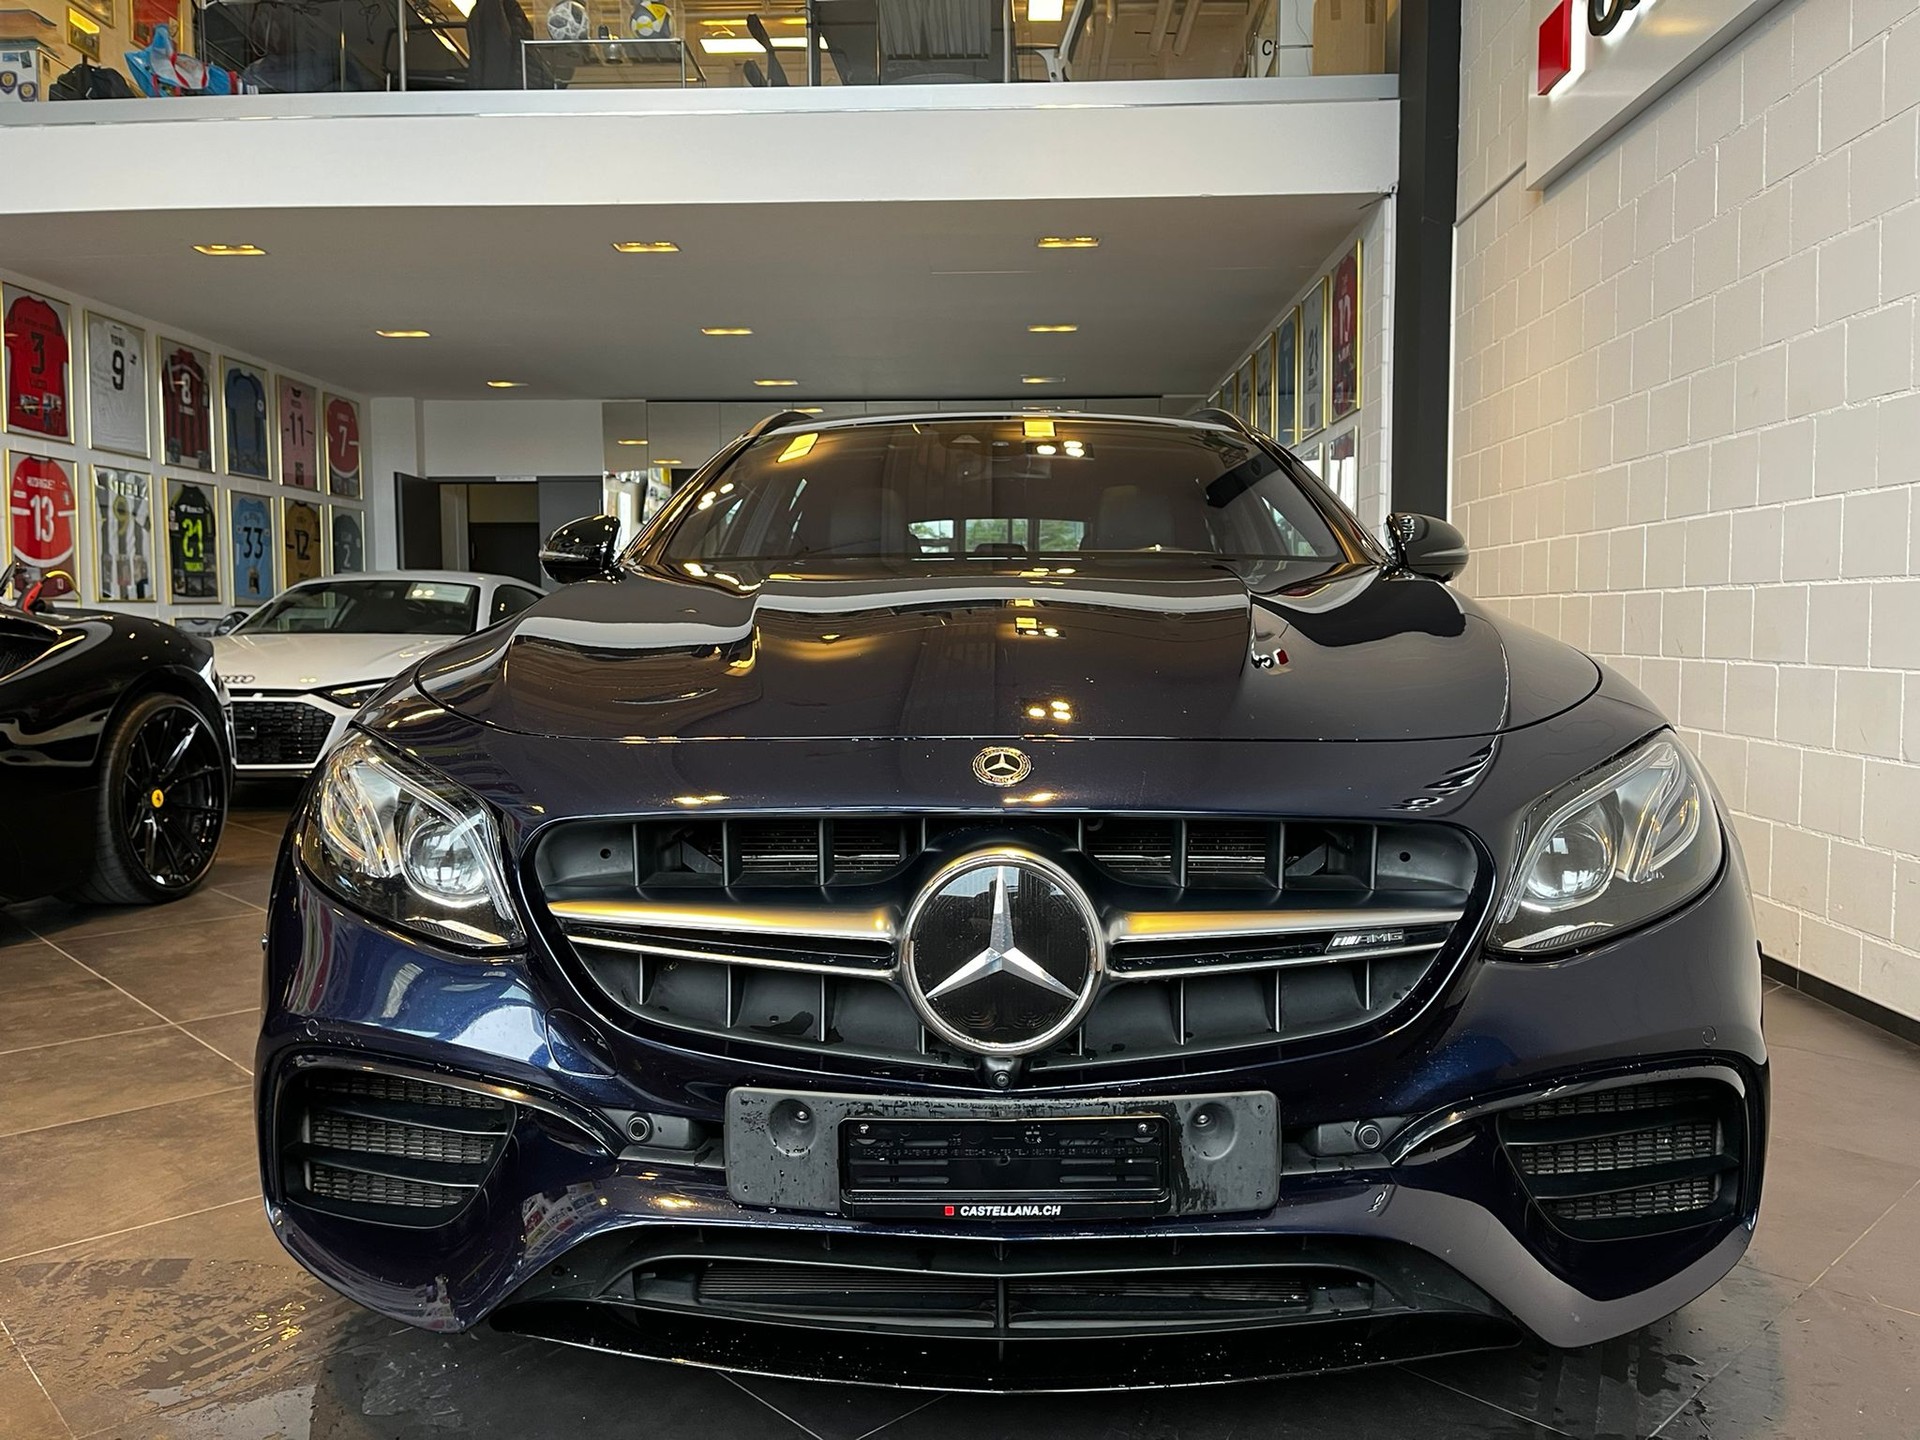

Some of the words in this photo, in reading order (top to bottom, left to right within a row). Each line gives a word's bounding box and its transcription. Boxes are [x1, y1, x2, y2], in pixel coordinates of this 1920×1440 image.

[30, 331, 45, 375] 3
[112, 350, 125, 391] 9
[181, 372, 193, 405] 8
[290, 411, 305, 447] 11
[338, 425, 348, 457] 7
[30, 494, 55, 543] 13
[182, 518, 204, 558] 21
[243, 526, 264, 559] 33
[960, 1205, 1061, 1217] CASTELLANA.CH
